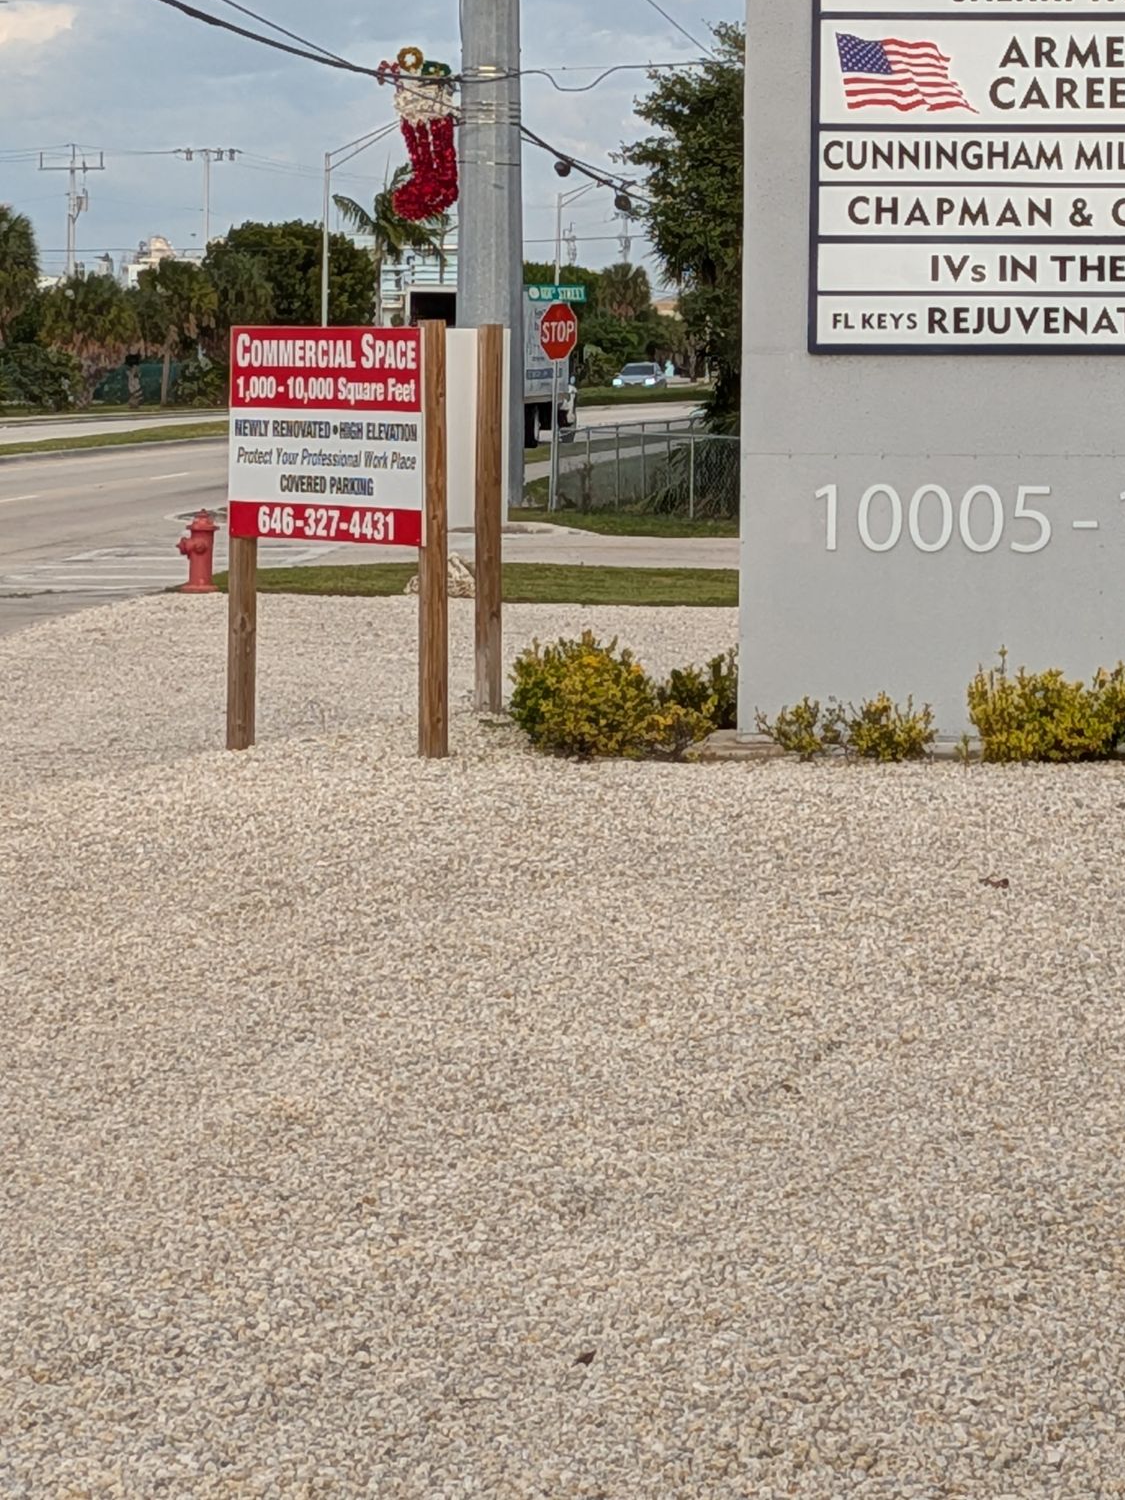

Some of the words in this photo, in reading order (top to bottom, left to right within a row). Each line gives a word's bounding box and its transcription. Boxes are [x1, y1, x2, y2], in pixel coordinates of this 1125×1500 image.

[824, 141, 1062, 170] CUNNINGHAM
[848, 196, 1051, 226] CHAPMAN
[1069, 198, 1092, 227] &
[932, 255, 985, 282] IVs
[1000, 256, 1036, 282] IN
[1050, 256, 1125, 281] THE
[542, 321, 575, 343] STOP
[833, 313, 854, 329] FL
[862, 313, 917, 329] KEYS
[237, 334, 356, 368] COMMERCIAL
[361, 334, 416, 369] SPACE
[237, 376, 276, 402] 1,000
[287, 377, 333, 404] 10,000
[338, 377, 384, 404] Square
[388, 378, 415, 402] Feet
[235, 419, 269, 437] NEWLY
[273, 420, 330, 439] RENOVATED
[339, 422, 363, 440] HIGH
[366, 423, 417, 441] ELEVATION
[237, 447, 272, 464] Protect
[277, 448, 298, 464] Your
[301, 449, 361, 467] Professional
[365, 452, 387, 468] Work
[391, 452, 416, 470] Place
[280, 475, 326, 493] COVERED
[330, 476, 373, 496] PARKING
[258, 505, 395, 540] 646-327-4431
[816, 484, 1050, 551] 10005
